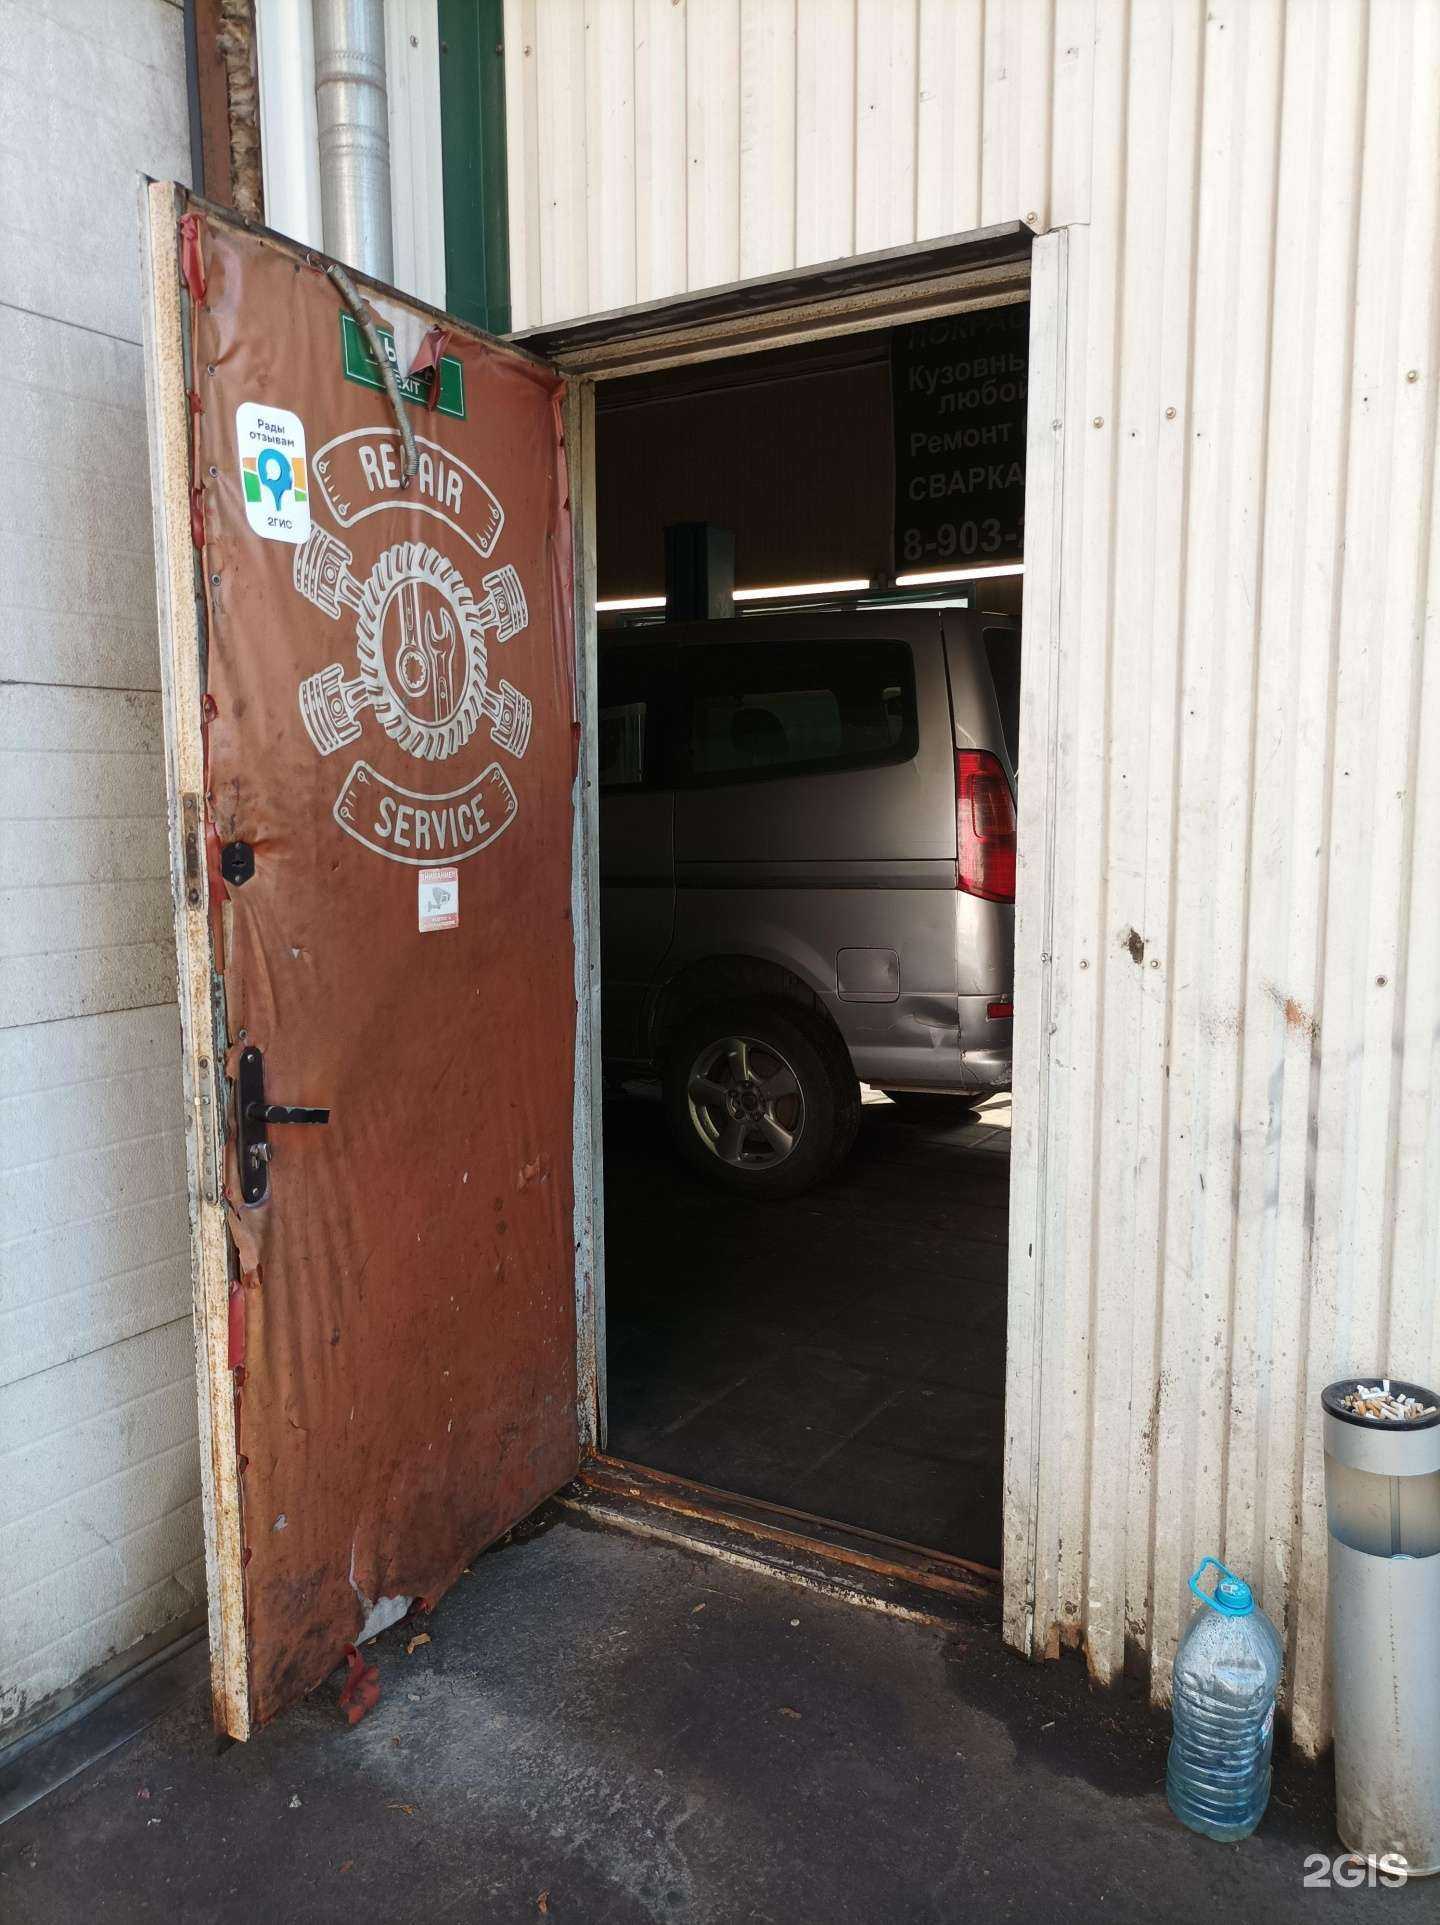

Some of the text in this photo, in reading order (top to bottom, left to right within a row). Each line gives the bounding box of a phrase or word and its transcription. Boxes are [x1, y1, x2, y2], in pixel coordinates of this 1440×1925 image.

[249, 431, 295, 447] отзывам
[257, 418, 285, 434] Рады
[910, 422, 1013, 457] Ремонт
[358, 443, 464, 514] REAIR
[908, 461, 1025, 501] СВАРКА
[267, 516, 293, 530] 2ГИС
[374, 793, 490, 850] SERVICE
